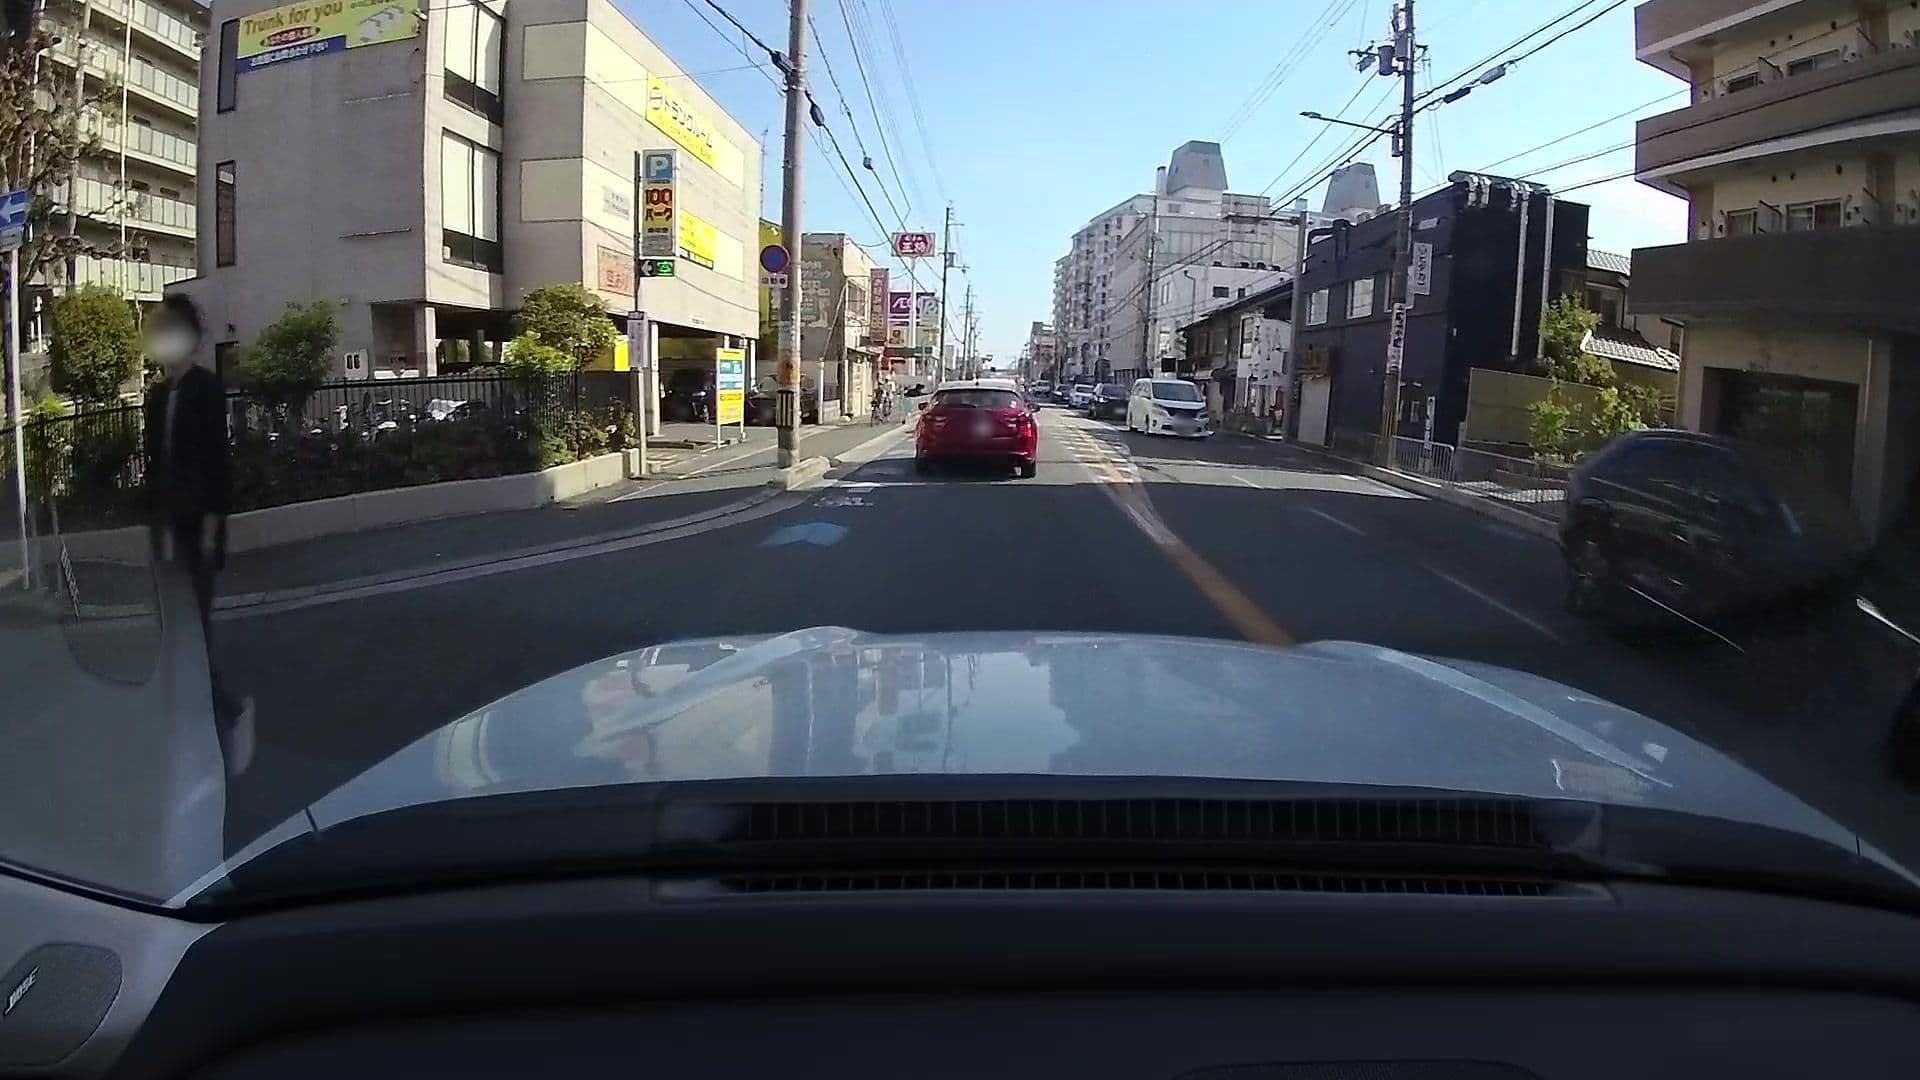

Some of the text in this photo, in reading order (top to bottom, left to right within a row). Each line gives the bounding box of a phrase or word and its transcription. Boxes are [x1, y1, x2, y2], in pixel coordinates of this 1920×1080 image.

[245, 2, 343, 35] Trunk for you
[650, 156, 669, 177] P
